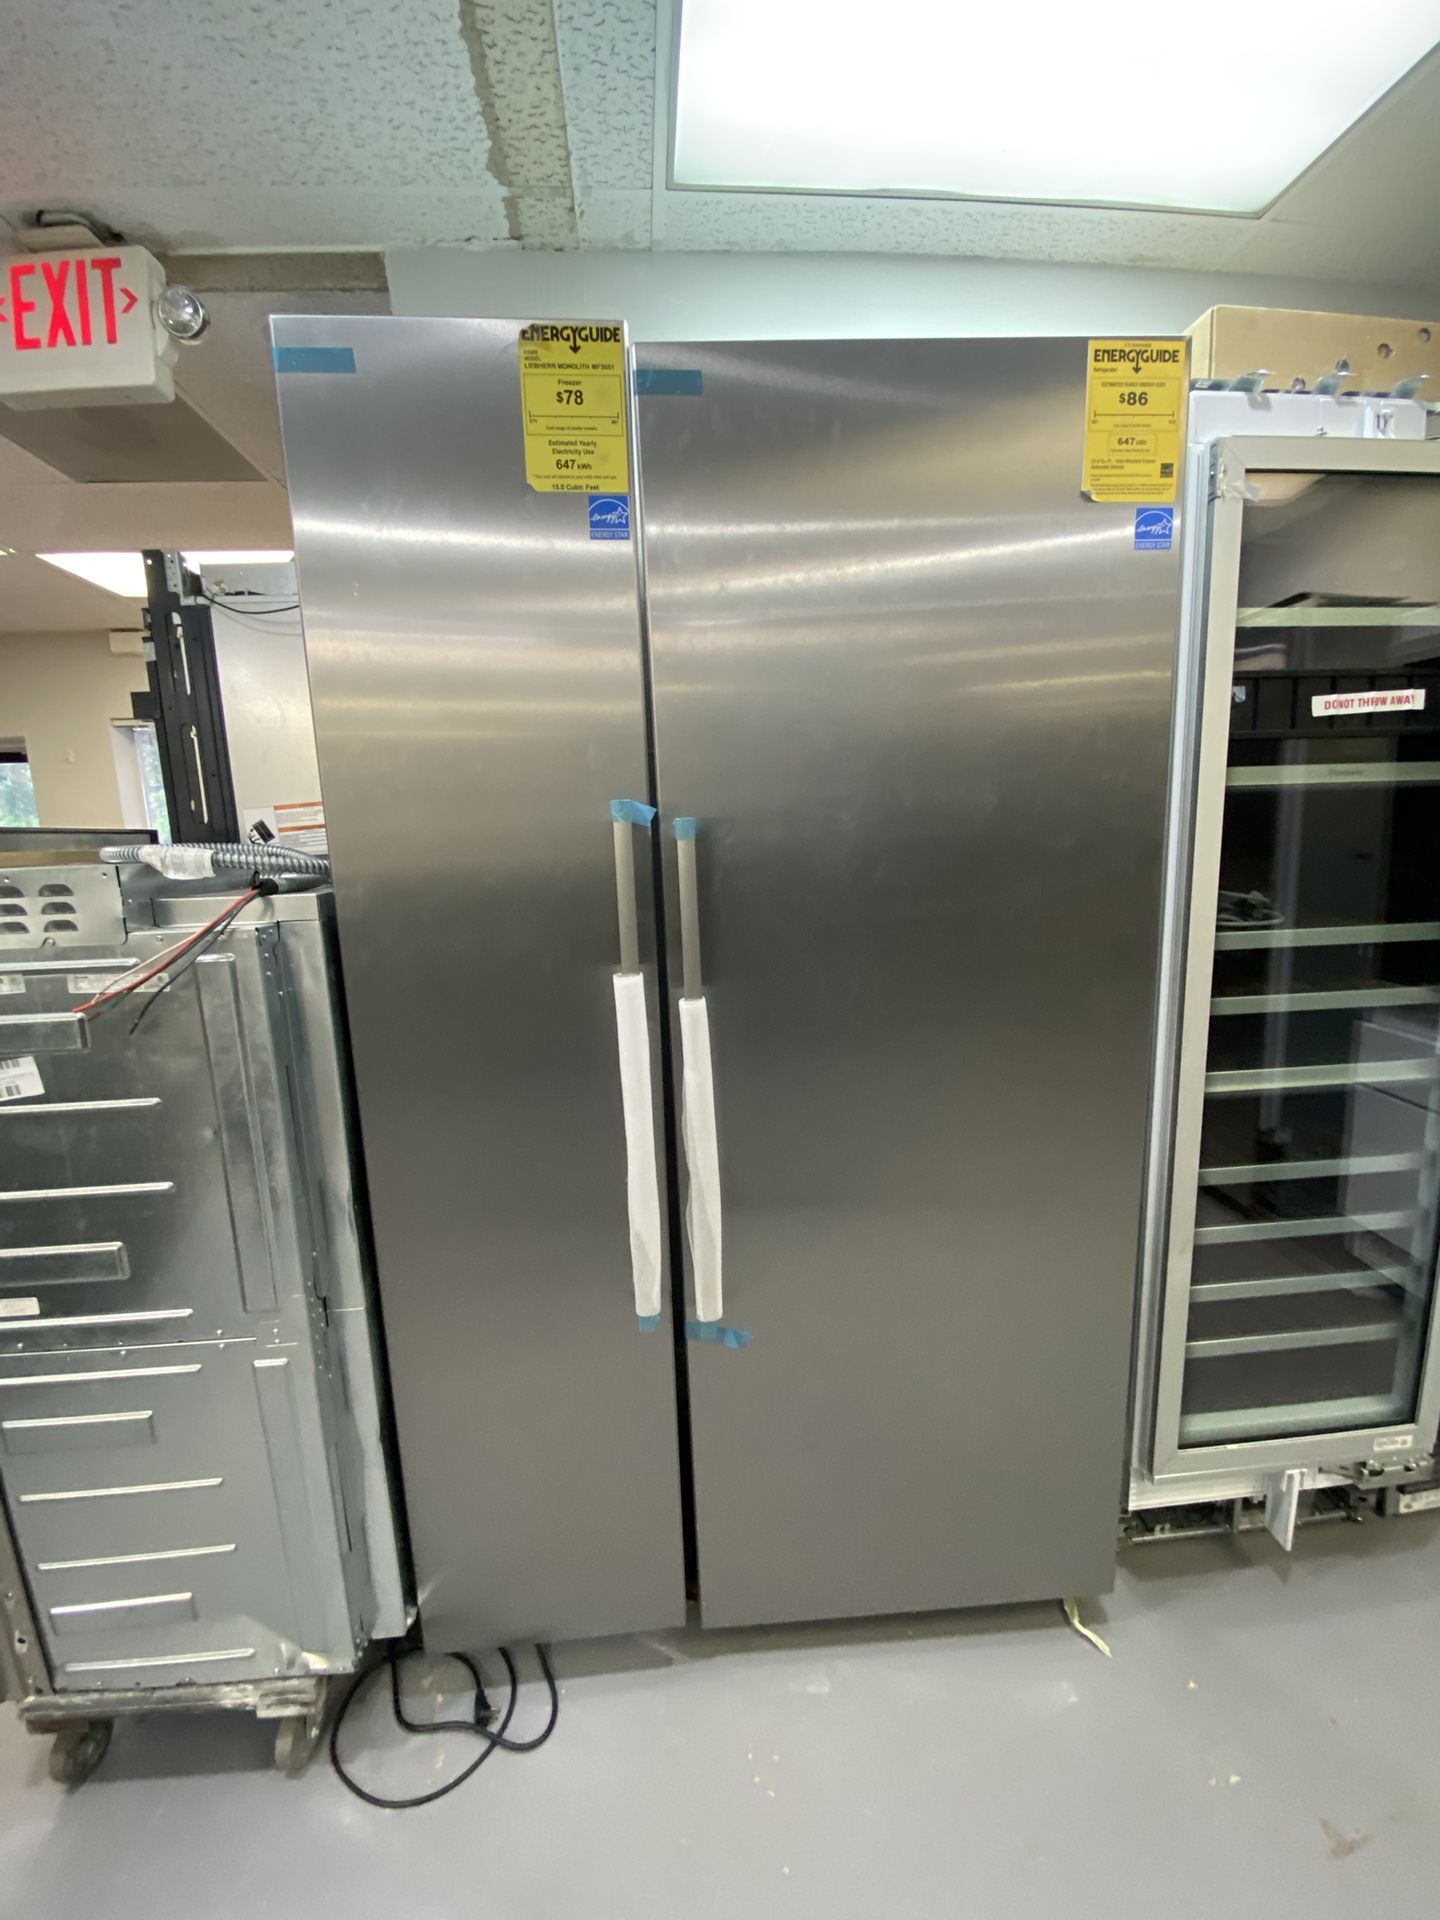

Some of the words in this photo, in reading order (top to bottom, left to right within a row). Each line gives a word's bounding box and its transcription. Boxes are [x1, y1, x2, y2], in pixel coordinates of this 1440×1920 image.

[9, 257, 122, 350] EXIT
[521, 323, 621, 343] ENERGYGUIDE
[1093, 349, 1179, 363] ENERGYGUIDE
[556, 389, 584, 405] $78
[1119, 392, 1148, 406] $86
[578, 440, 597, 448] Yearly
[1117, 437, 1135, 445] 647
[552, 448, 582, 456] Electricity
[556, 459, 576, 470] 647
